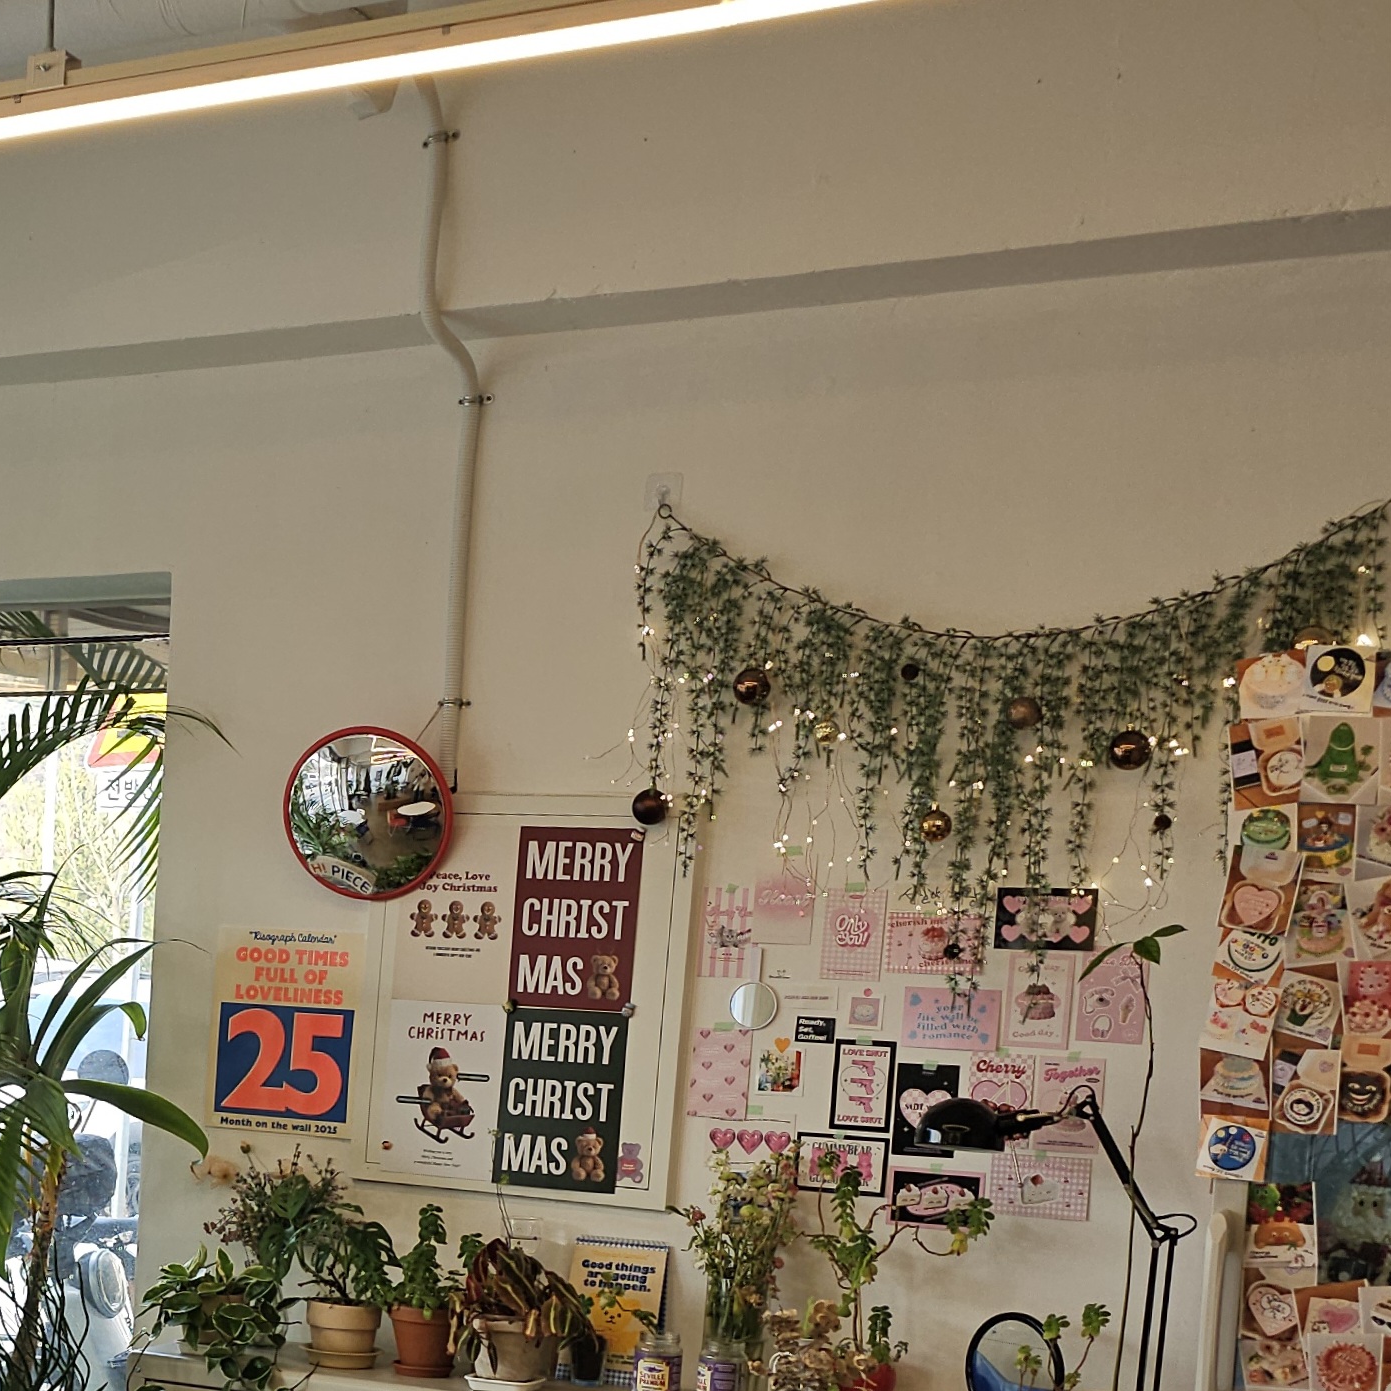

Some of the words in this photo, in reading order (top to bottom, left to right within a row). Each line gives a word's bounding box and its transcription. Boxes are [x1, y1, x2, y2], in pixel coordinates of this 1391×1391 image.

[525, 840, 634, 882] MERRY
[331, 863, 372, 894] PIECE
[465, 871, 491, 881] Love
[420, 883, 438, 893] Joy
[442, 883, 498, 893] Christmas
[521, 897, 629, 941] CHRIST
[835, 914, 869, 935] Only
[835, 931, 871, 947] You!
[235, 946, 291, 964] GOOD
[294, 949, 350, 967] TIMES
[254, 966, 298, 984] FULL
[303, 968, 328, 985] OF
[516, 954, 584, 995] MAS
[234, 984, 343, 1006] LOVELINESS
[422, 1011, 472, 1026] MERRY
[511, 1021, 619, 1065] MERRY
[843, 1048, 864, 1056] LOVE
[220, 1008, 344, 1116] 25
[976, 1059, 1027, 1079] Cherry
[1043, 1066, 1101, 1083] Together
[507, 1077, 614, 1122] CHRIST
[220, 1116, 252, 1127] Month
[255, 1119, 268, 1129] on
[271, 1121, 288, 1131] the
[291, 1123, 311, 1133] wall
[314, 1124, 338, 1135] 2025
[837, 1114, 858, 1122] LOVE
[501, 1132, 568, 1175] MAS
[582, 1259, 613, 1270] Good
[615, 1262, 656, 1275] things
[583, 1279, 597, 1287] to
[612, 1272, 647, 1284] going
